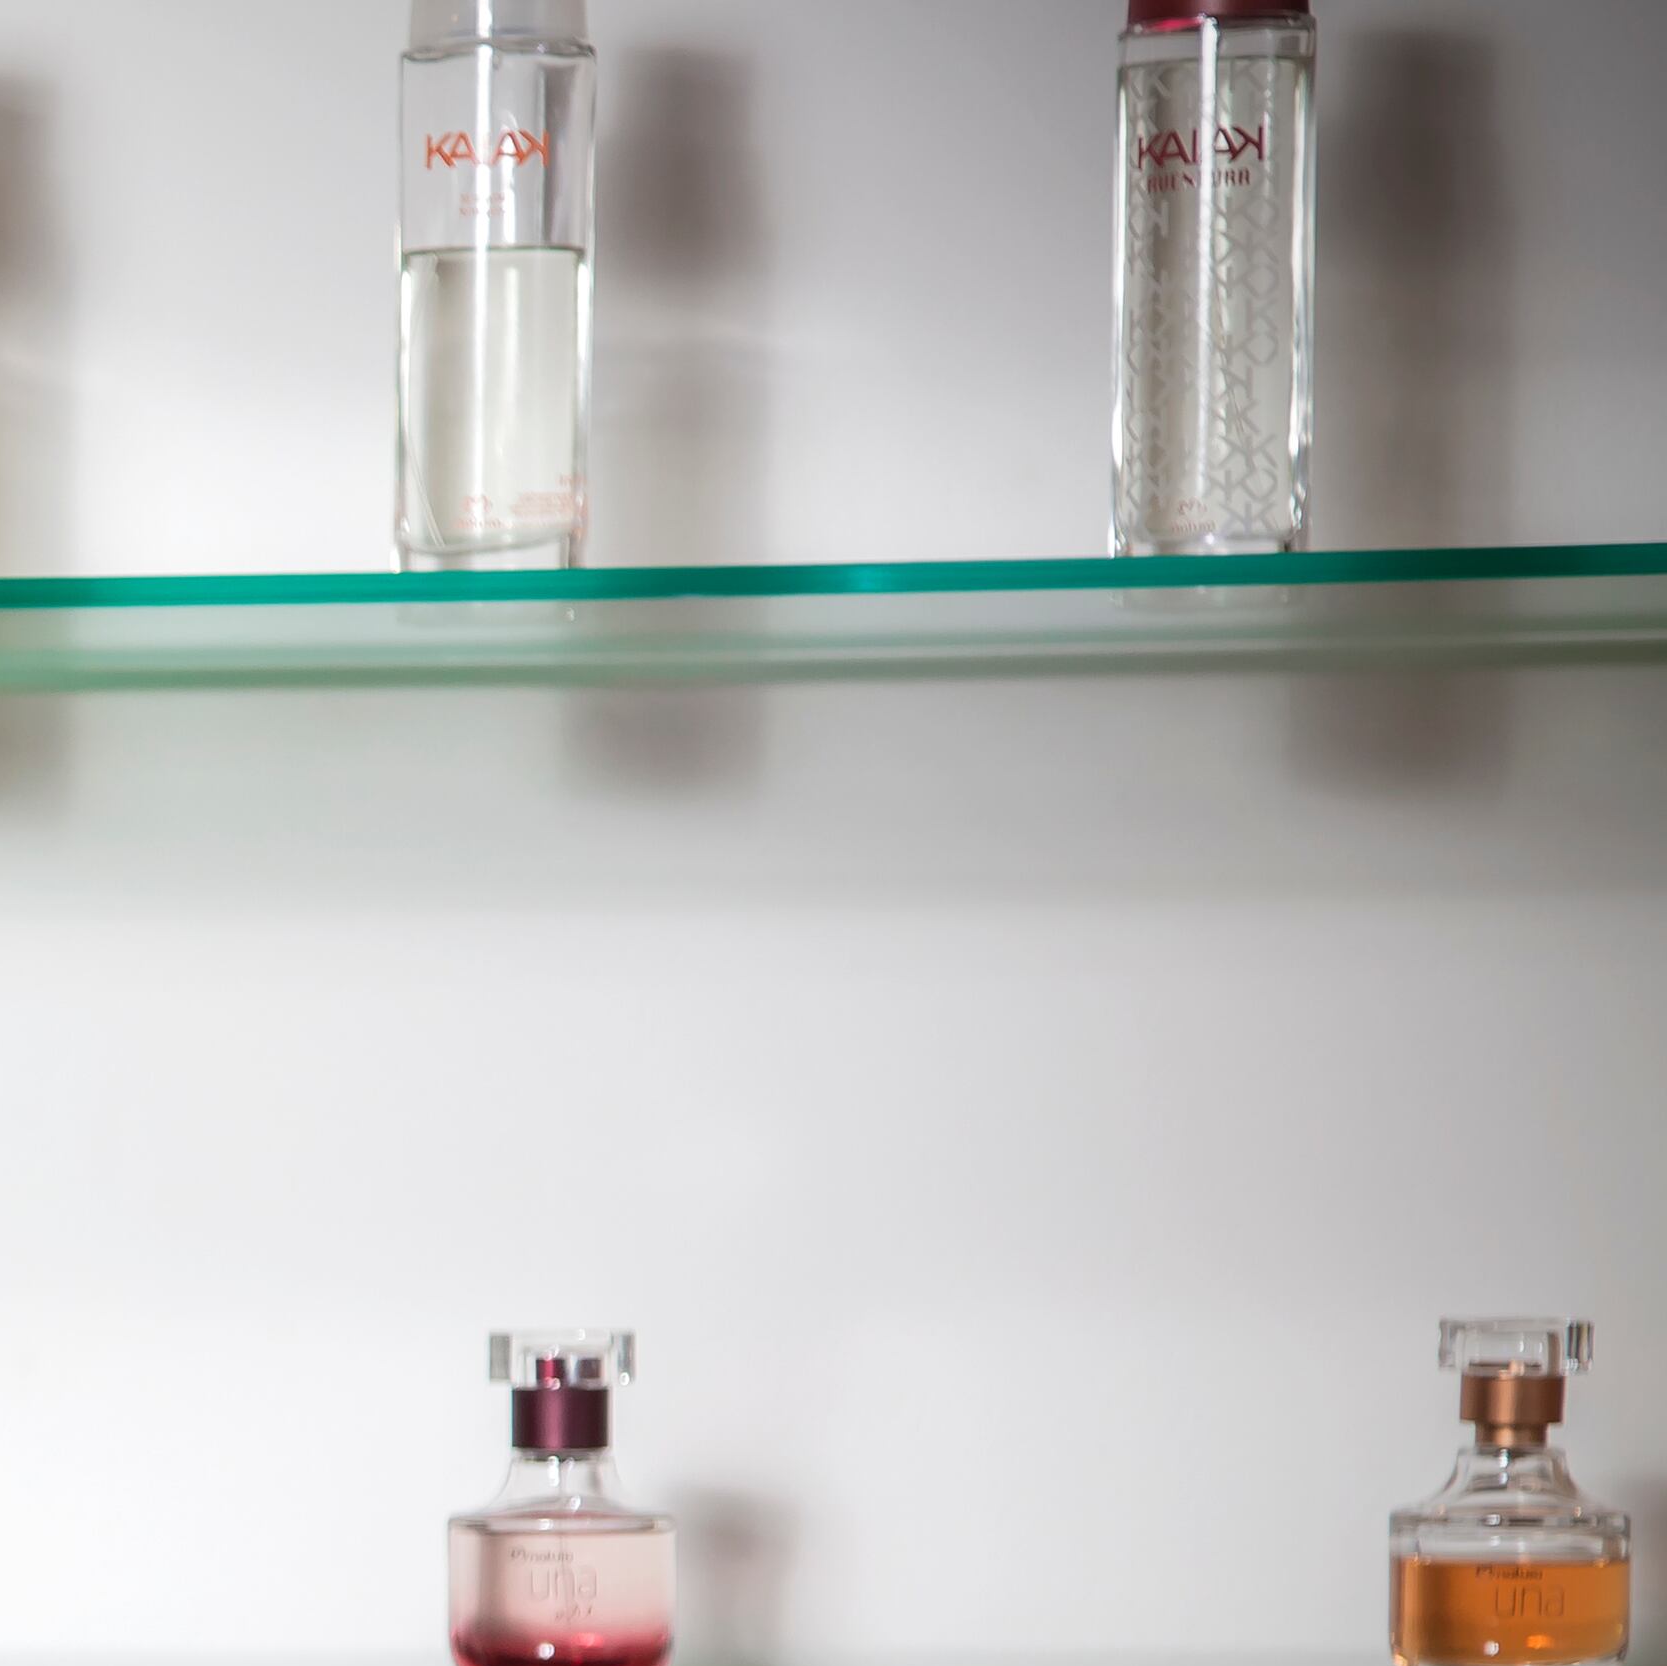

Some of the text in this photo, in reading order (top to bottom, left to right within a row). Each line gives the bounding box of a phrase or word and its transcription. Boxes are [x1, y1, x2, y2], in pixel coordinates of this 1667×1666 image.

[425, 129, 551, 170] KAAK
[1138, 124, 1265, 171] KAIAK
[1147, 168, 1251, 194] AVENURA
